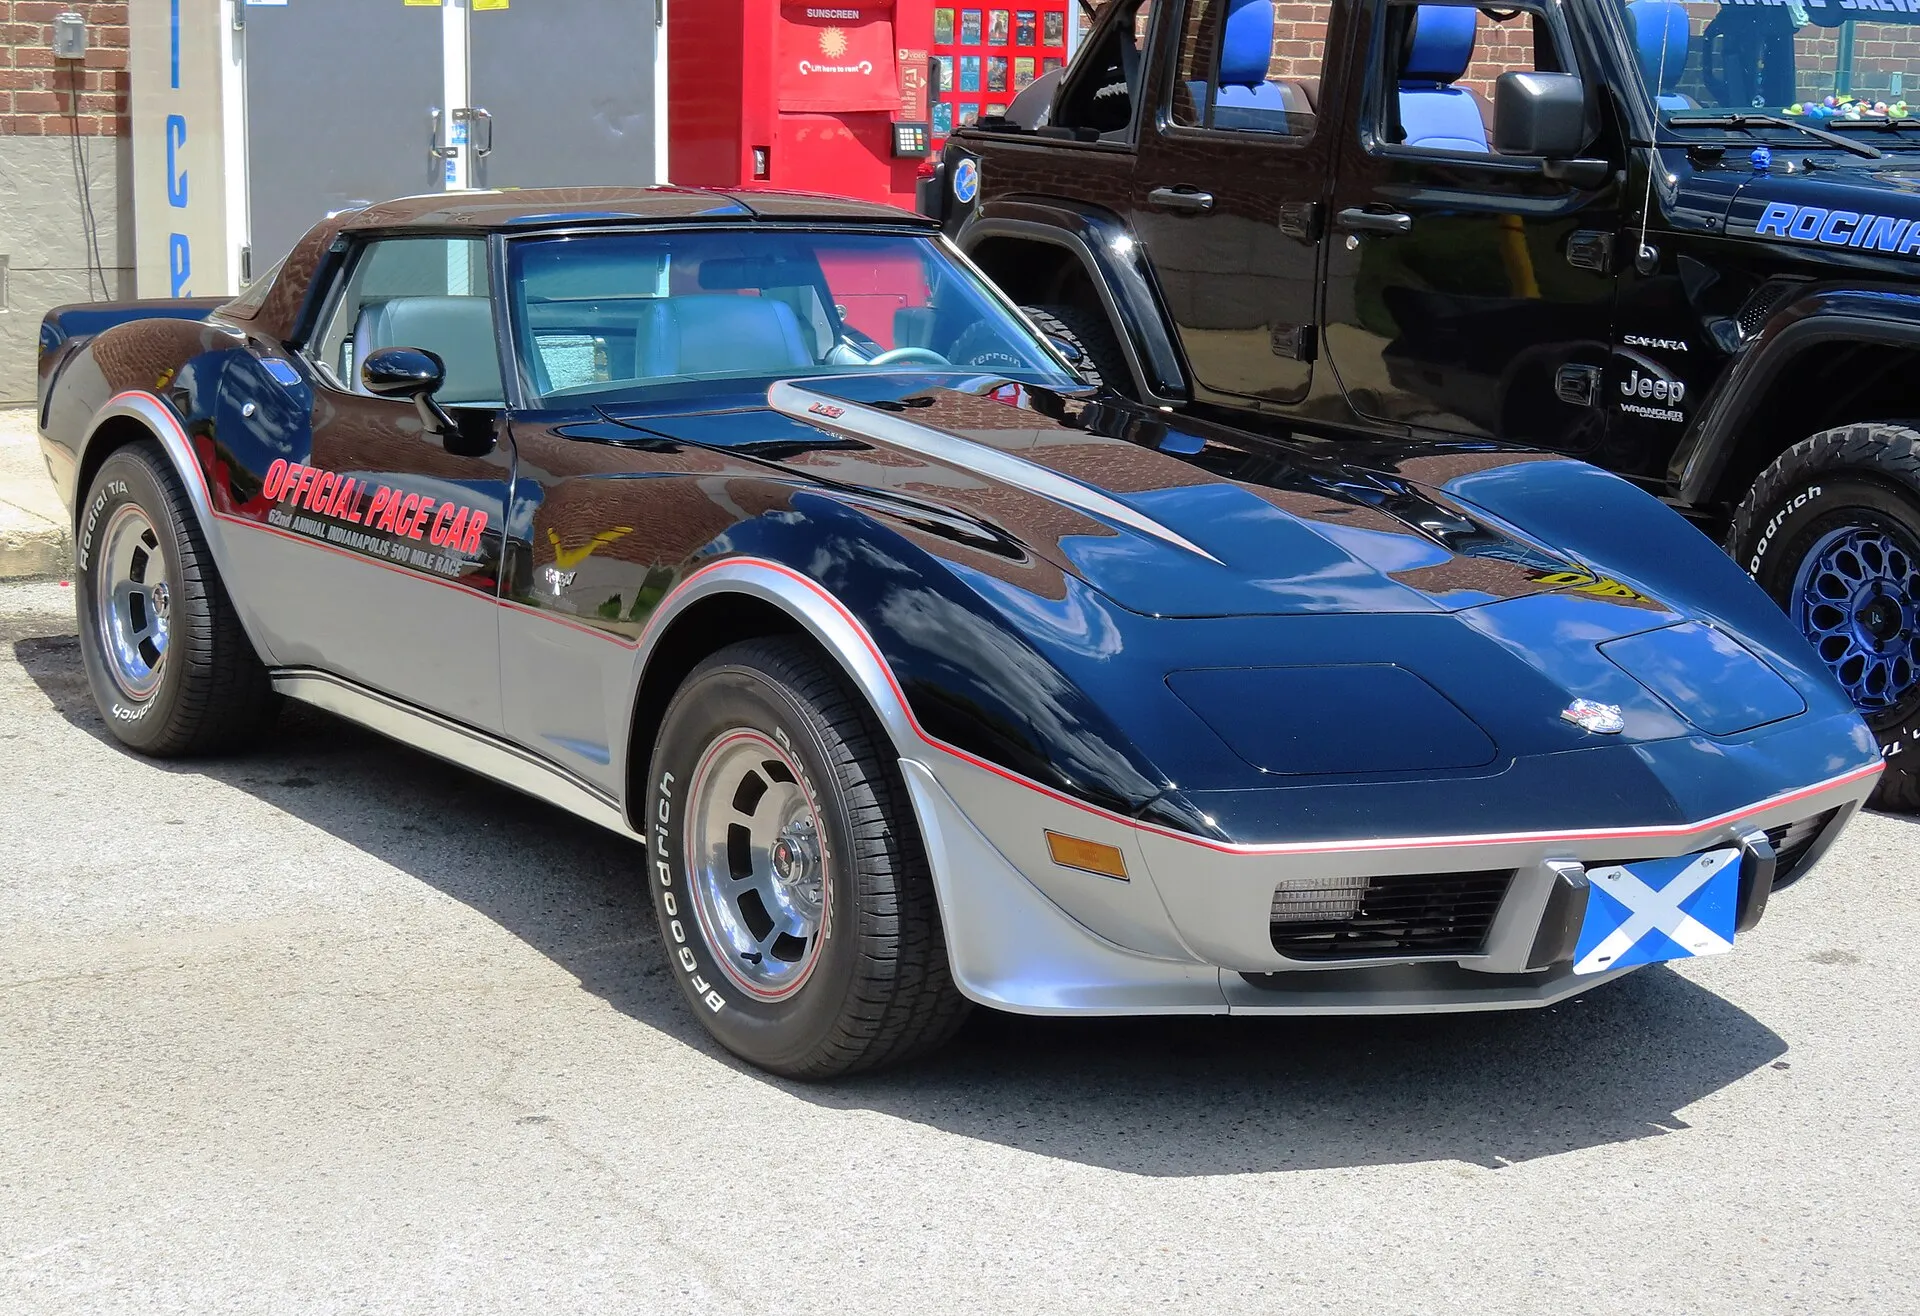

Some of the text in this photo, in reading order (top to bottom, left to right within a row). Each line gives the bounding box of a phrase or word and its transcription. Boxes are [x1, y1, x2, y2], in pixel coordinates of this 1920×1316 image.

[806, 8, 859, 19] SUNSCREEN
[811, 64, 822, 73] Lift
[822, 65, 837, 73] here
[844, 65, 859, 73] rent
[1623, 334, 1688, 352] SAHARA
[969, 352, 1021, 368] Terrain
[1620, 370, 1685, 406] Jeep
[1620, 402, 1684, 418] WRANGLER
[1640, 412, 1684, 423] UNLIMITED
[263, 458, 489, 556] OFFICIAL PACE CAR
[80, 480, 129, 571] Radial T/A
[268, 508, 462, 578] 62nd ANNUAL INDIANAPOLIS 500 MILE RACE
[655, 771, 727, 1014] BFGoodrich
